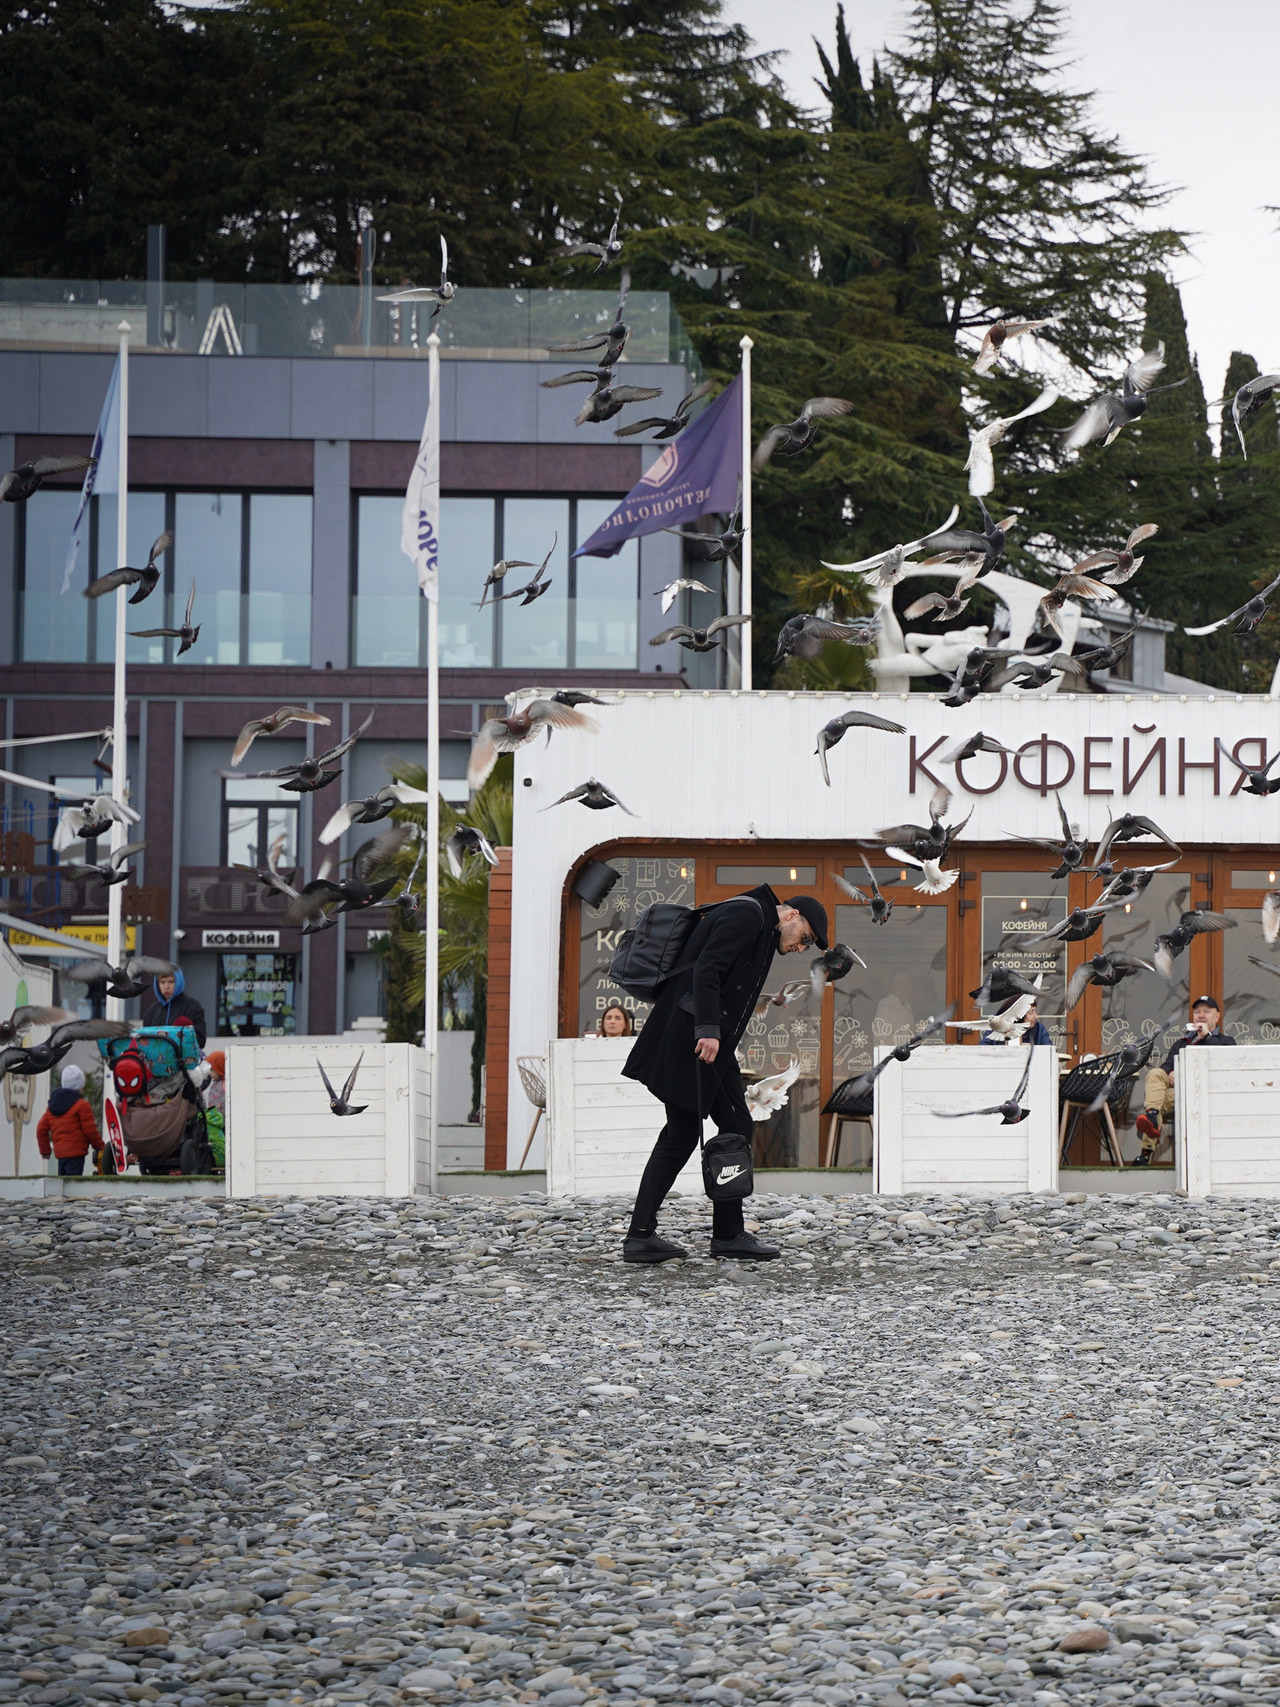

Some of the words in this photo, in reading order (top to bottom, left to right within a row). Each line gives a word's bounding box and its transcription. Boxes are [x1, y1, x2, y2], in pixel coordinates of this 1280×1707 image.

[908, 723, 1267, 798] КОФЕЙНЯ
[1002, 920, 1047, 930] КОФЕЙНЯ
[206, 931, 275, 945] КОФЕЙНЯ
[1028, 960, 1056, 969] 20:00
[720, 1164, 740, 1178] NIKE
